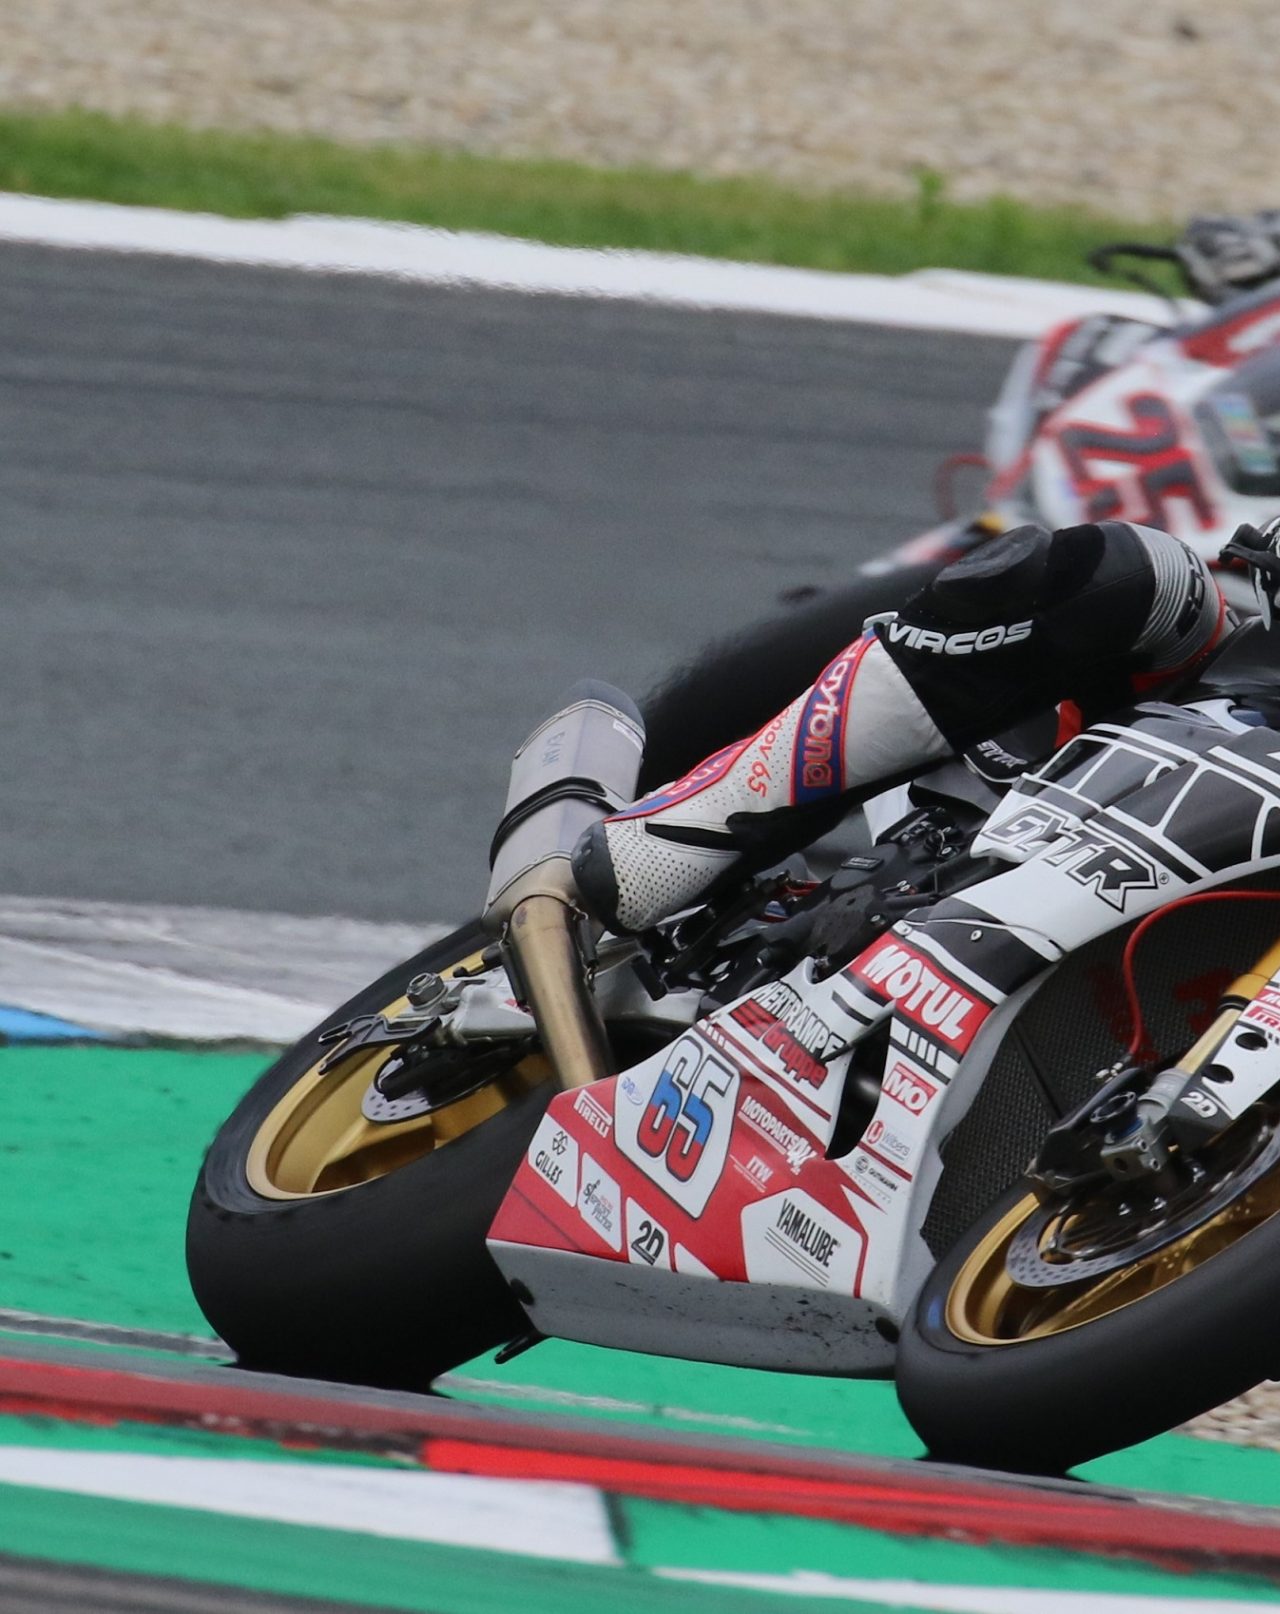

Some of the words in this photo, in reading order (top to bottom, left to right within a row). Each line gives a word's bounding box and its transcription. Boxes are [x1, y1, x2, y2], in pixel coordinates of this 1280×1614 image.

[888, 619, 1034, 656] VIRCOS
[803, 638, 865, 788] daytona
[980, 803, 1159, 914] GYTR
[862, 944, 976, 1041] MOTUL
[573, 1088, 614, 1138] PIRELLI
[637, 1035, 735, 1184] 65
[883, 1070, 929, 1111] MO
[1181, 1091, 1219, 1119] 2D
[535, 1150, 563, 1186] GILLES
[776, 1198, 839, 1268] YAMALUBE
